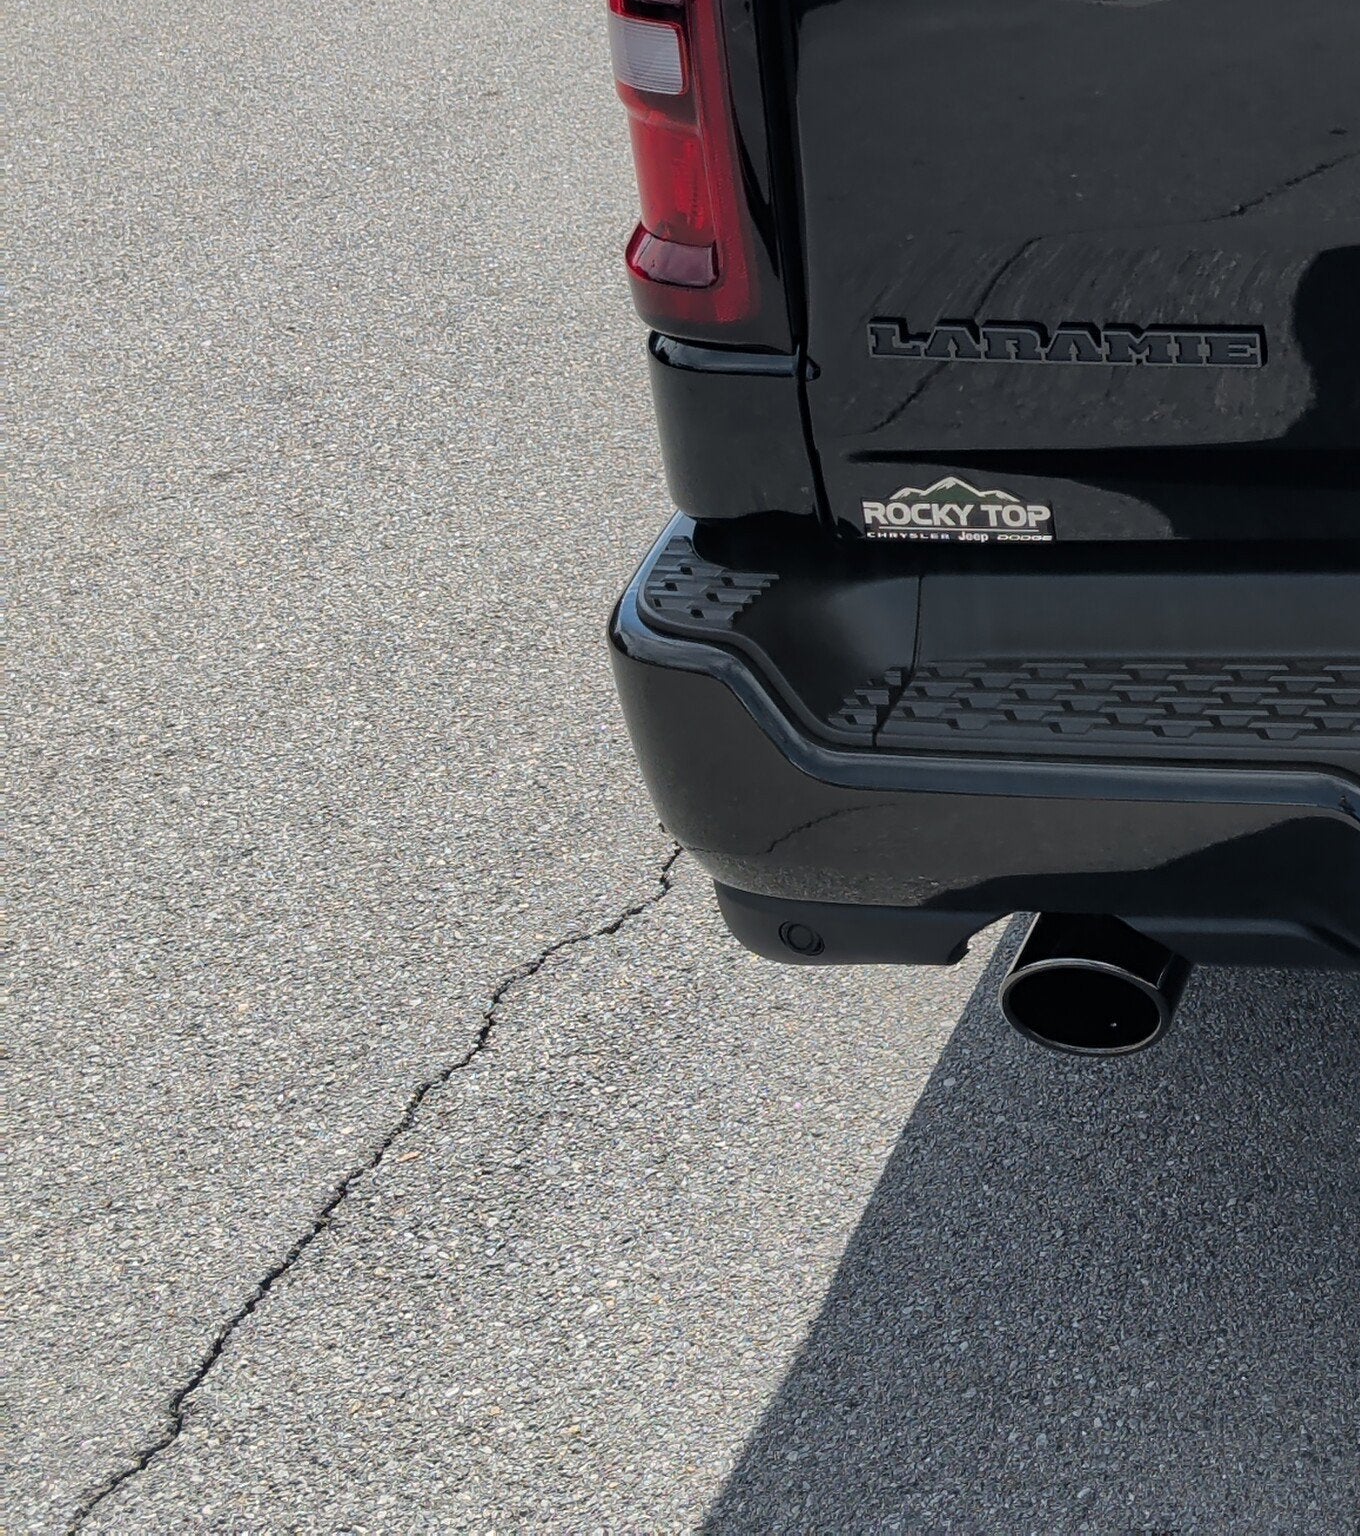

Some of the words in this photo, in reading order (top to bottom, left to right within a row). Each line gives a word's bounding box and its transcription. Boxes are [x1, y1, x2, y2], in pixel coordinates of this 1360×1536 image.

[867, 320, 1265, 368] LARAMIE
[862, 501, 974, 527] ROCKY
[980, 504, 1051, 527] TOP
[866, 531, 950, 540] CHRYSLER
[958, 531, 989, 543] Jeep
